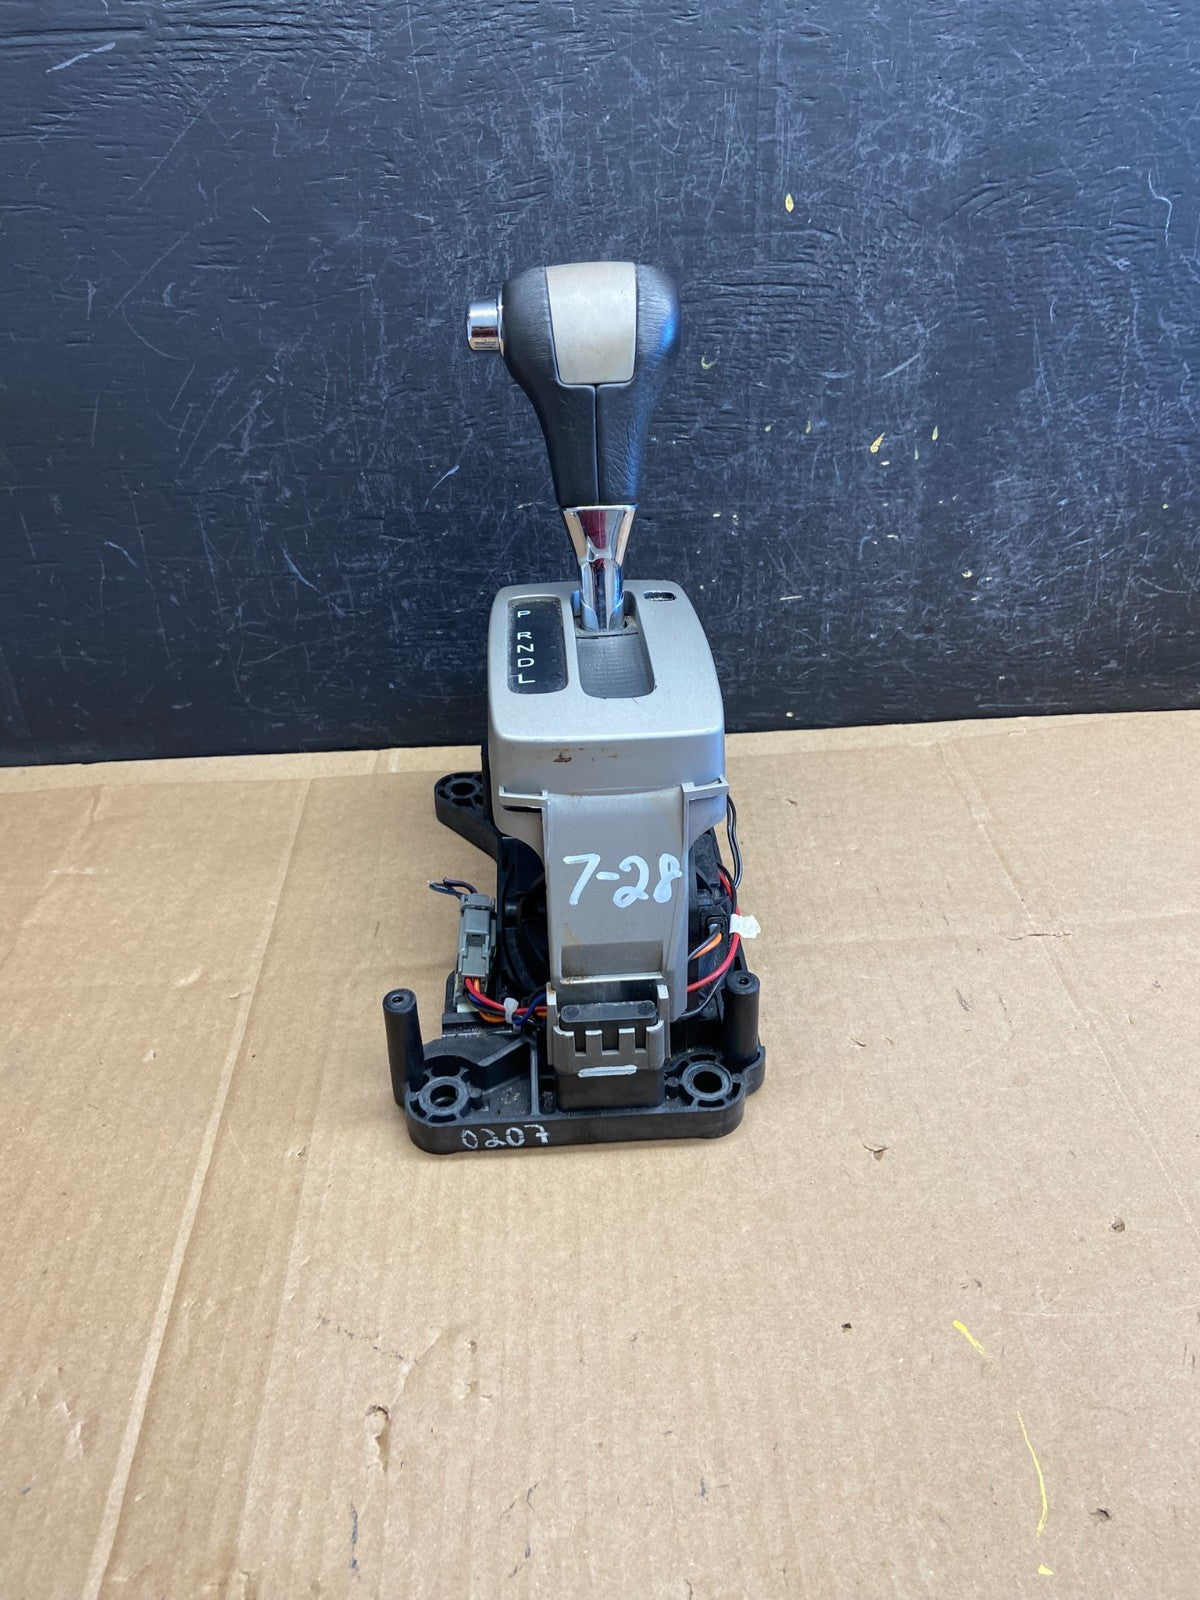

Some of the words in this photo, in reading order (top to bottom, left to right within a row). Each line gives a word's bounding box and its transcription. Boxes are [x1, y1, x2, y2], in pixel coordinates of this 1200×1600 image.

[517, 610, 531, 618] P
[517, 631, 532, 640] R
[517, 643, 534, 653] N
[517, 657, 535, 668] D
[518, 673, 536, 684] L
[563, 853, 682, 908] 7-28
[461, 1124, 550, 1149] 0207
